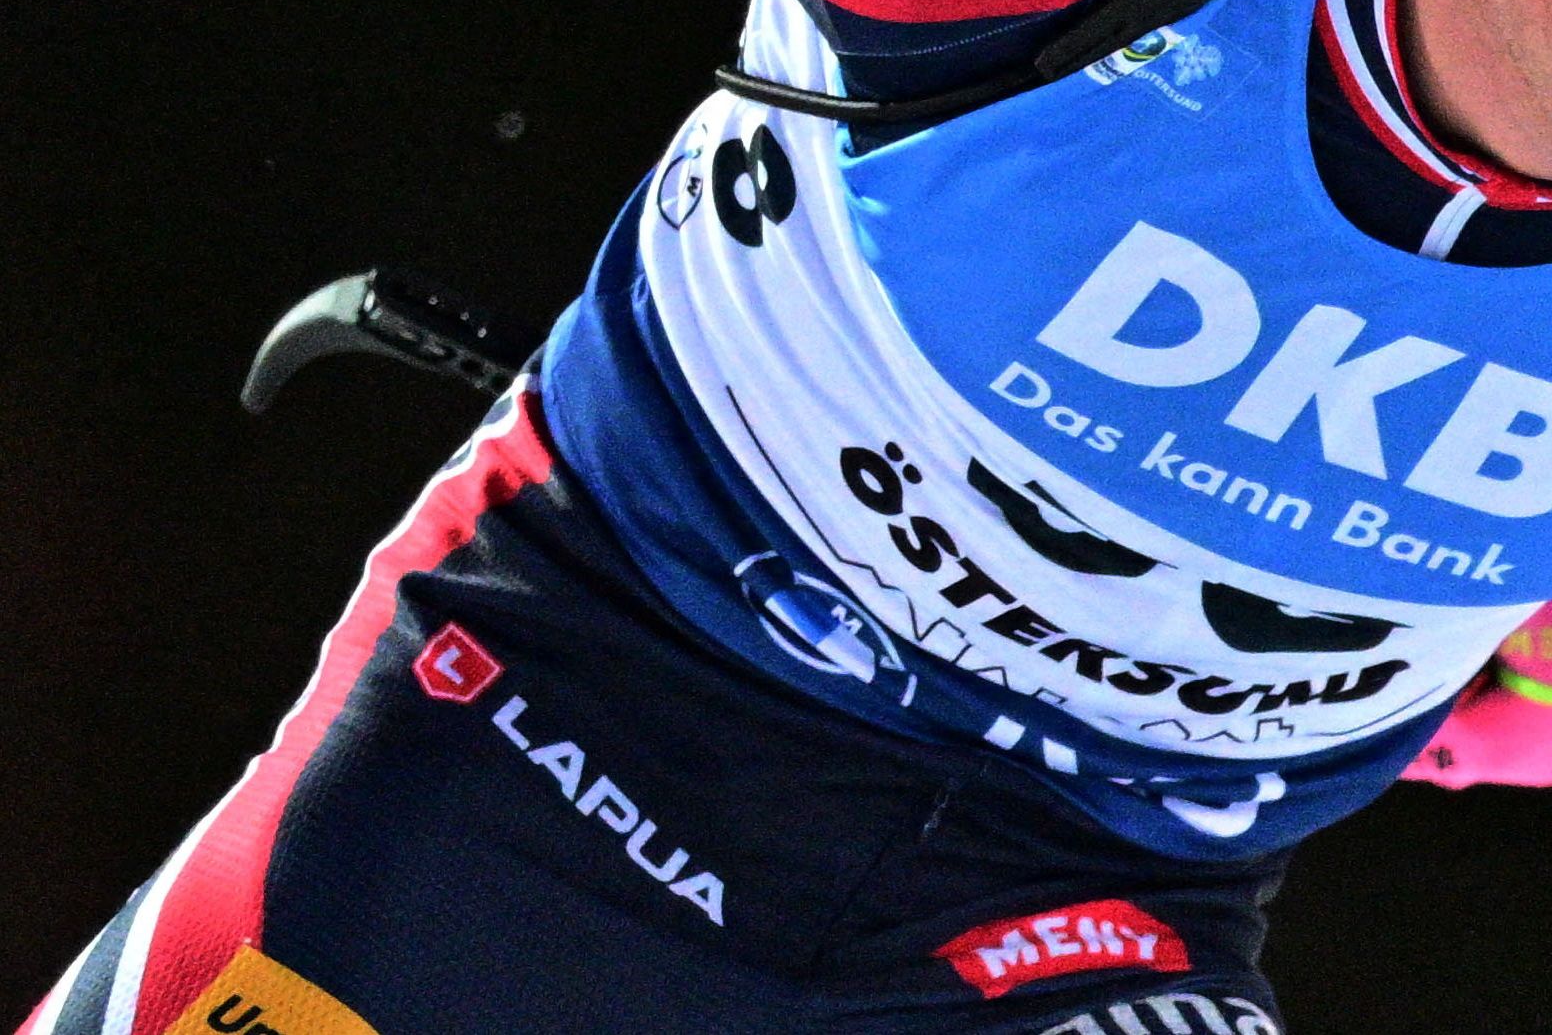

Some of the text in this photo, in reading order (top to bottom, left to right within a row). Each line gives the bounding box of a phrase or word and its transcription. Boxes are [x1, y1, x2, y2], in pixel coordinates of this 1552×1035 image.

[711, 123, 798, 248] 8
[988, 361, 1518, 586] Das kann Bank
[491, 694, 726, 927] LAPUA
